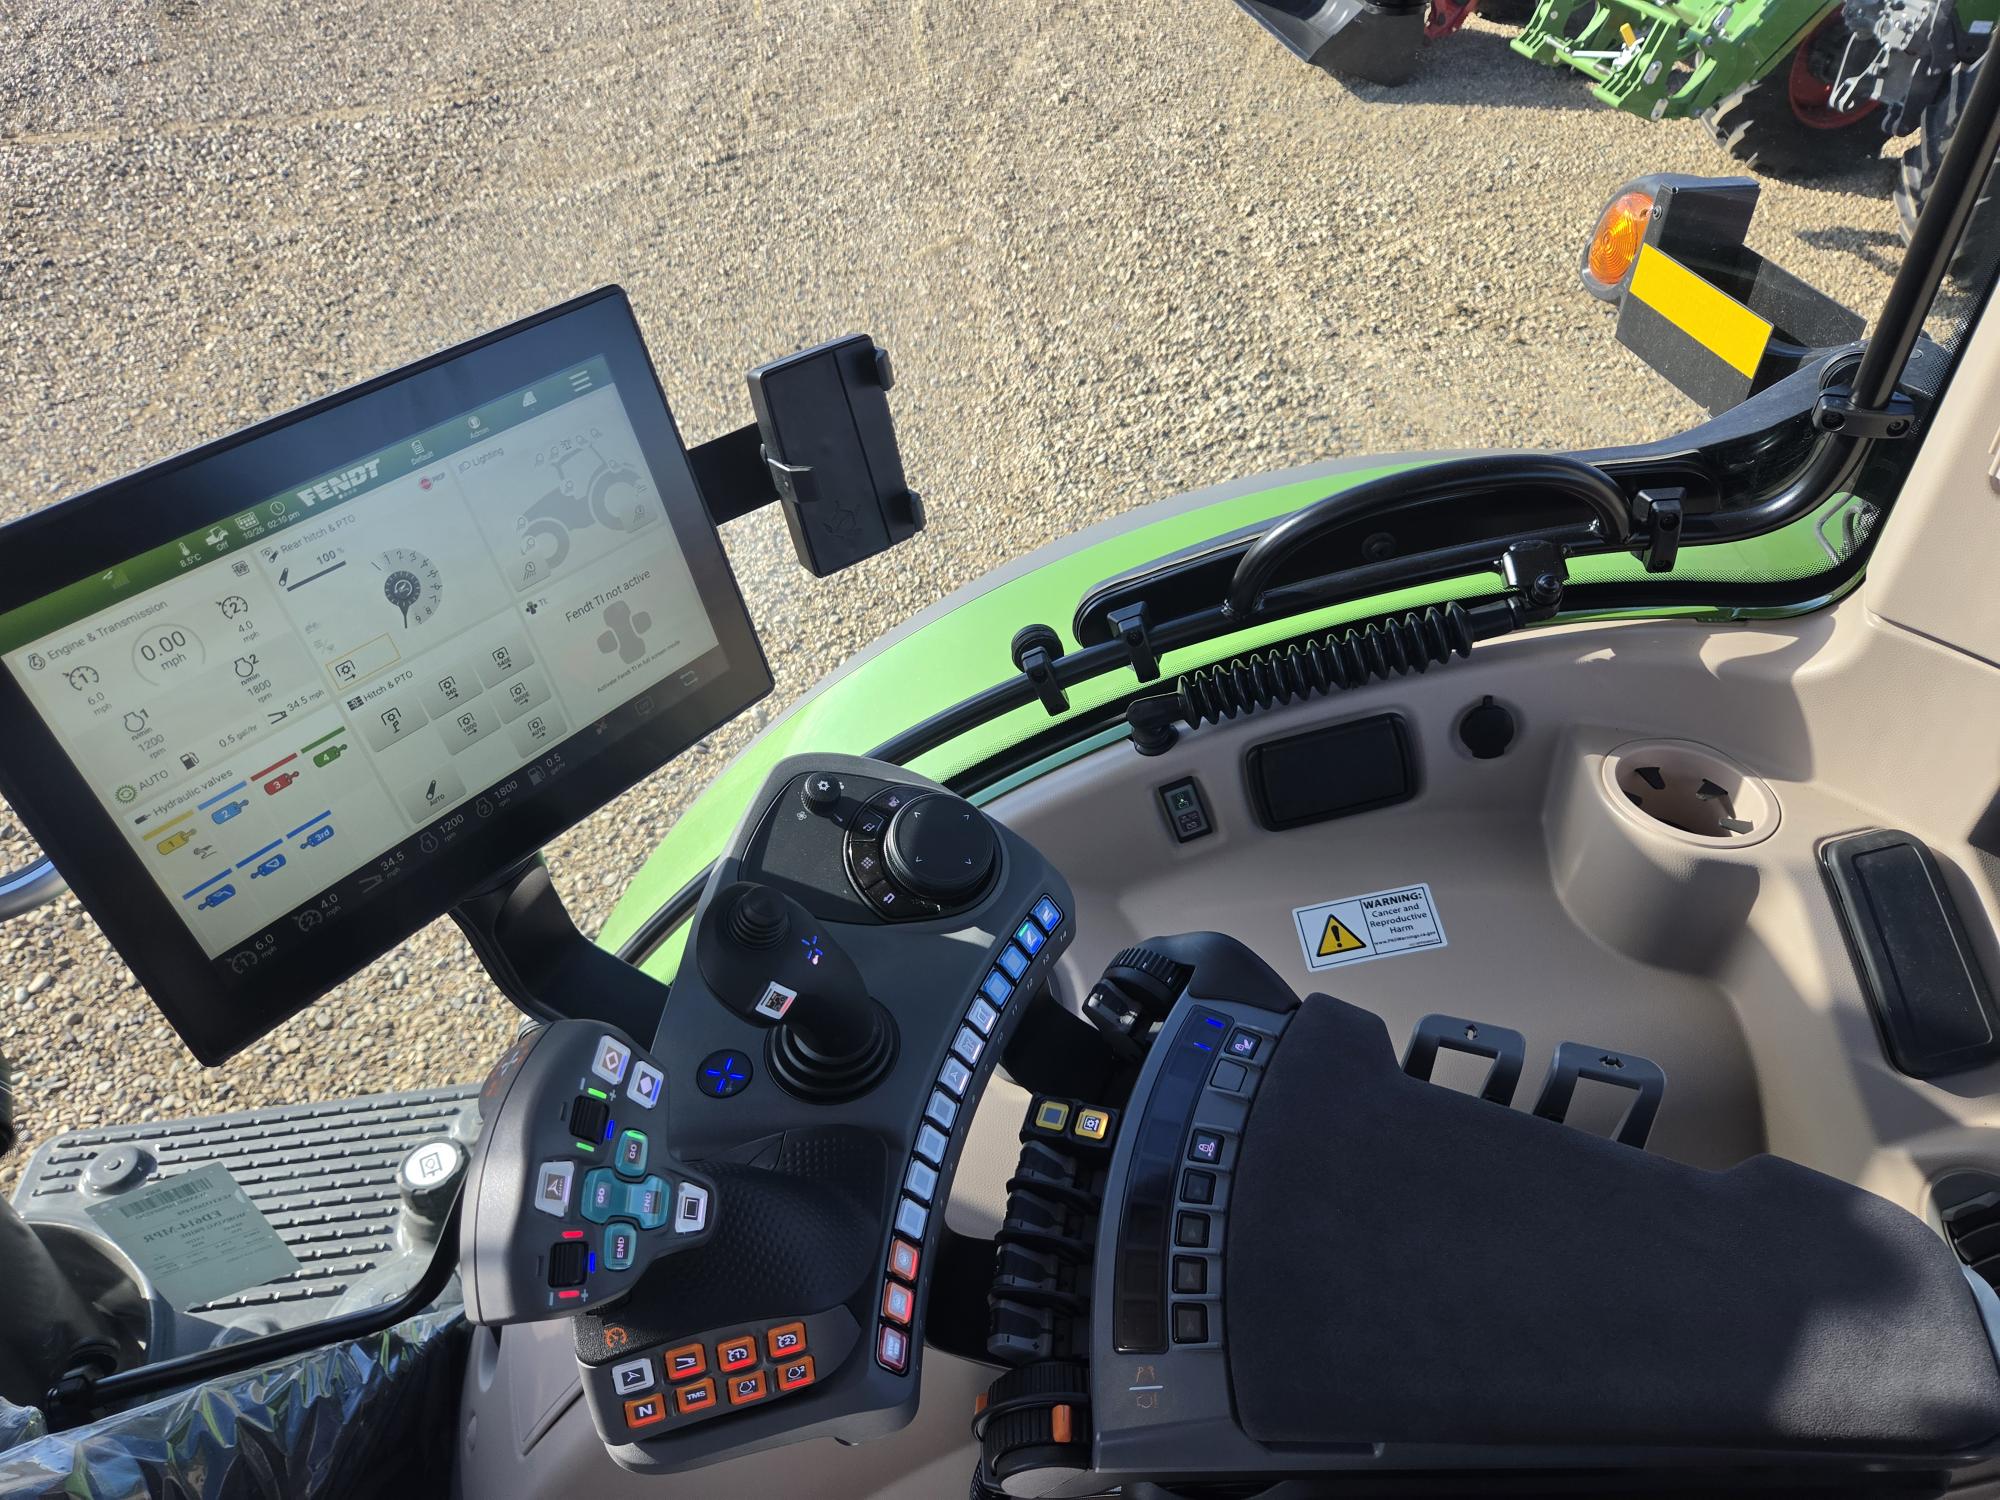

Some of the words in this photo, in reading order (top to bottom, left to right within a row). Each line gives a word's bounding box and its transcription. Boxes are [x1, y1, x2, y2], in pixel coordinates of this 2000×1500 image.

[472, 448, 504, 468] Lighting
[297, 458, 380, 507] FENDT
[288, 511, 300, 523] pm
[280, 540, 302, 554] Rear
[305, 526, 328, 545] hitch
[329, 523, 337, 533] &
[337, 515, 356, 528] PTO
[216, 541, 229, 552] Off
[180, 553, 202, 568] 8.5°C
[317, 550, 337, 565] 100
[565, 599, 594, 623] Fendt
[605, 586, 623, 601] not
[623, 570, 651, 592] active
[48, 639, 86, 661] Engine
[86, 632, 96, 642] &
[97, 600, 169, 637] Transmission
[238, 620, 253, 633] 4.0
[141, 631, 186, 661] 0.00
[161, 653, 187, 670] mph
[248, 680, 271, 696] 1800
[363, 683, 387, 703] Hitch
[387, 678, 394, 689] &
[394, 670, 414, 685] PTO
[88, 691, 105, 705] 6.0
[286, 695, 308, 712] 34.5
[308, 689, 325, 702] mph
[93, 702, 113, 716] mph
[532, 725, 546, 737] AUTO
[137, 734, 165, 753] 1200
[219, 734, 235, 749] 0.5
[149, 746, 167, 760] rpm
[323, 752, 330, 762] 4
[546, 753, 561, 767] 0.5
[138, 769, 168, 791] AUTO
[273, 781, 281, 790] 3
[153, 787, 201, 816] Hydraulic
[201, 769, 233, 791] valves
[494, 780, 518, 800] 1800
[429, 793, 445, 807] AUTO
[222, 811, 230, 819] 2
[440, 814, 464, 834] 1200
[315, 828, 330, 841] 3rd
[380, 851, 405, 871] 34.5
[321, 893, 338, 909] 4.0
[1363, 892, 1422, 910] WARNING:
[1371, 907, 1401, 918] Cancer
[1402, 903, 1420, 914] and
[1370, 912, 1427, 927] Reproductive
[1390, 924, 1414, 934] Harm
[255, 934, 274, 951] 6.0
[629, 1143, 638, 1160] GO
[596, 1187, 606, 1205] GO
[643, 1191, 652, 1213] END
[616, 1236, 625, 1259] END
[686, 1389, 706, 1401] TMS
[638, 1404, 653, 1417] N
